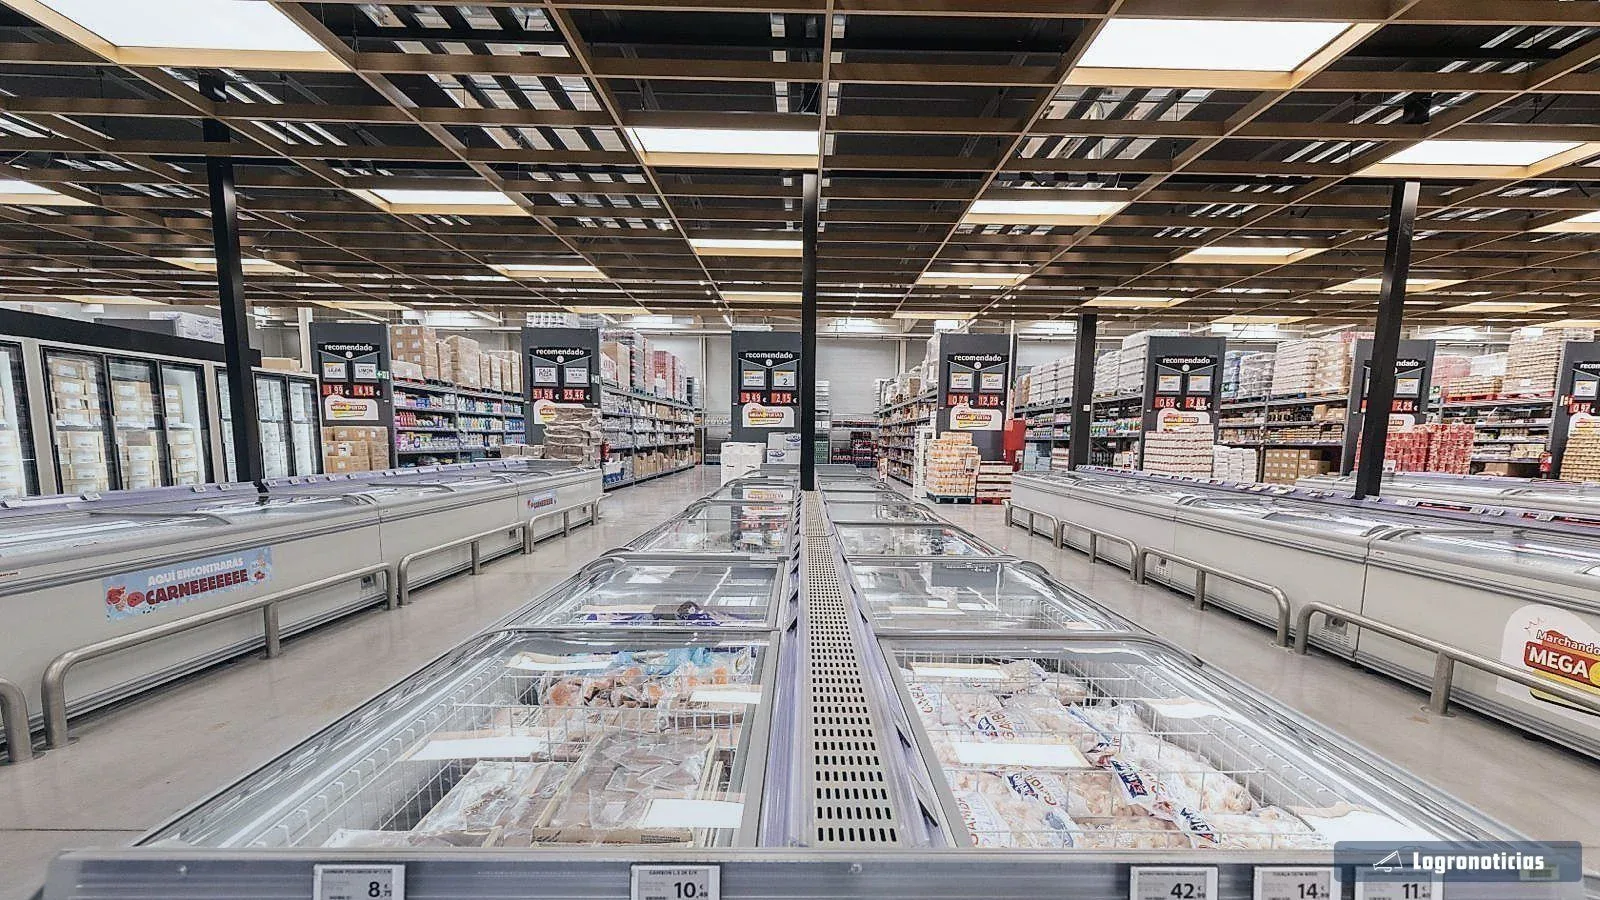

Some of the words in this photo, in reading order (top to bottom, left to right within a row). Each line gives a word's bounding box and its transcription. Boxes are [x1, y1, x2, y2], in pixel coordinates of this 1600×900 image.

[536, 348, 584, 356] recomendado
[954, 354, 1002, 362] recomendado
[1162, 356, 1210, 364] recomendado
[146, 569, 248, 605] CARNEEEEEEE
[1529, 646, 1589, 679] MEGA
